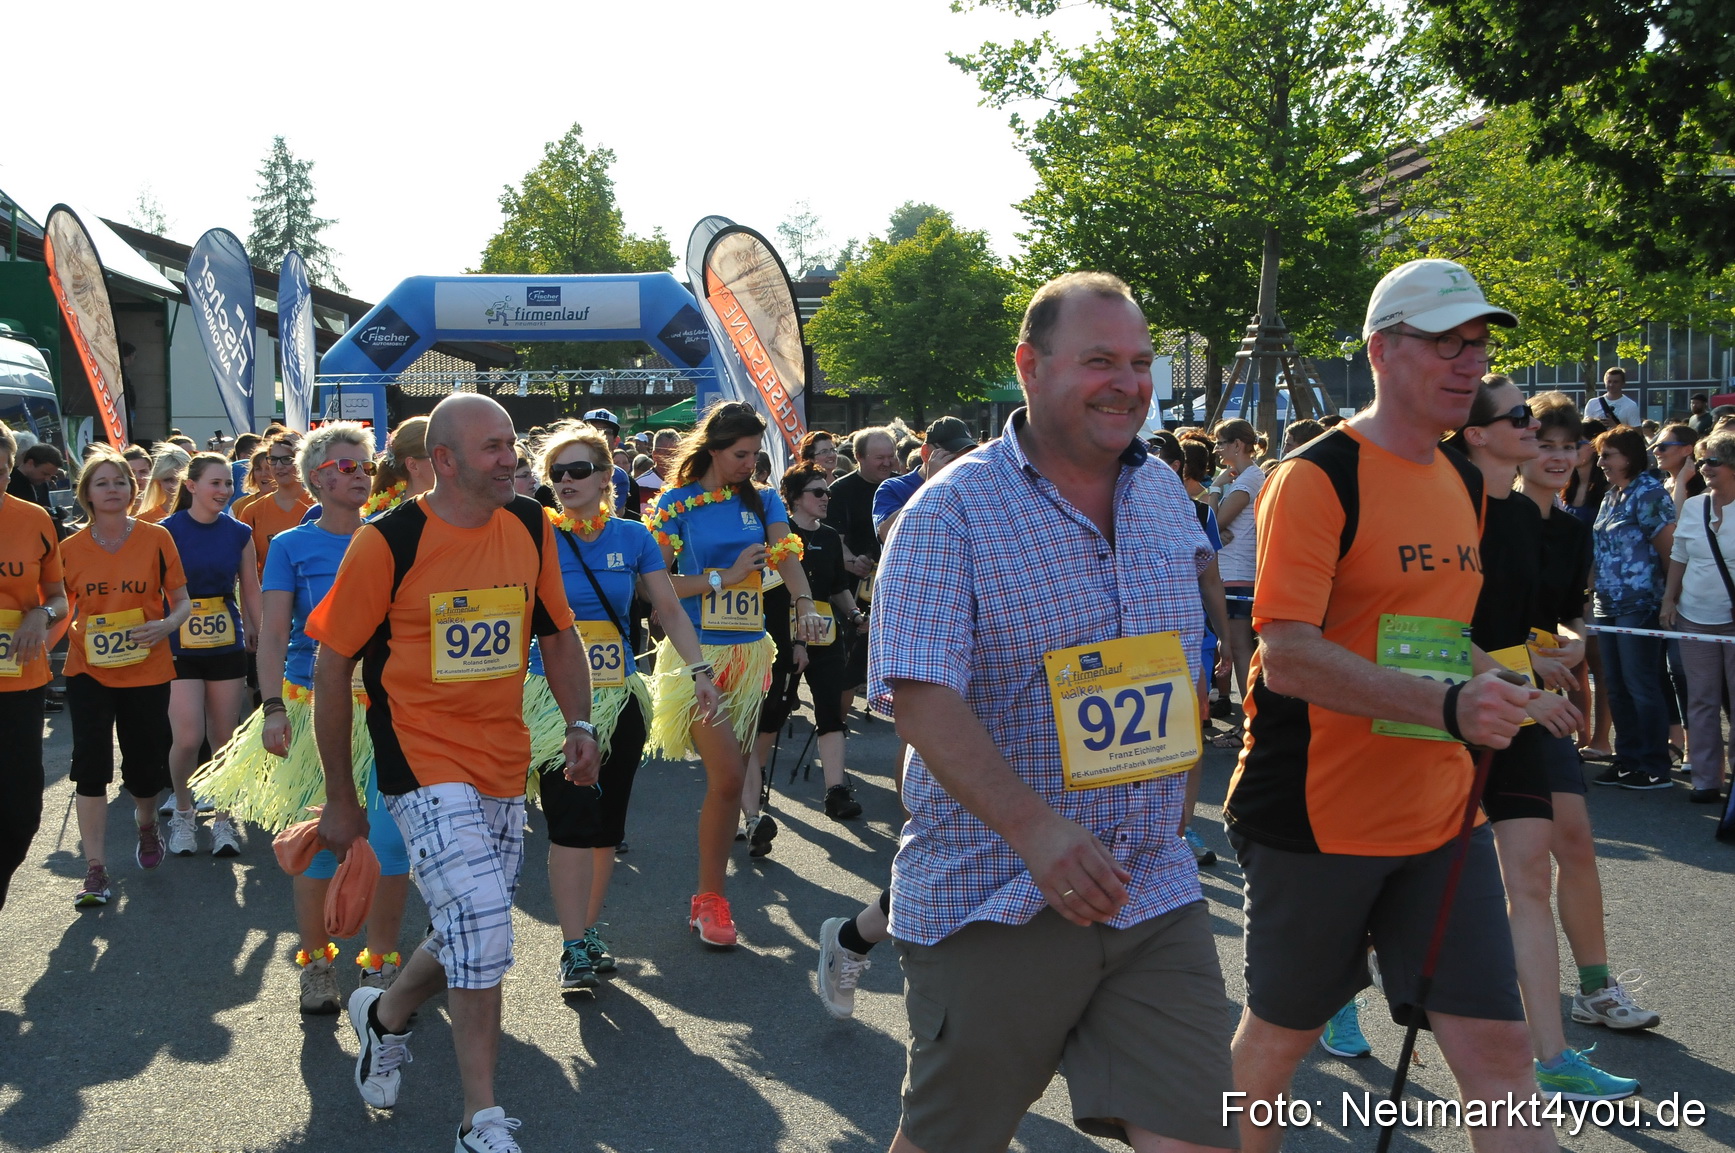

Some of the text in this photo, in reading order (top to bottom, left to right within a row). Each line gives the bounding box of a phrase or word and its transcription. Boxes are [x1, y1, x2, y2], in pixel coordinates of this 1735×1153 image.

[515, 307, 590, 320] firmenlauf
[368, 332, 410, 342] Fischer
[122, 581, 146, 593] KU
[705, 590, 759, 615] 1161
[188, 614, 227, 636] 656
[437, 617, 465, 625] walken
[93, 630, 139, 655] 925
[445, 620, 511, 659] 928
[588, 644, 621, 670] 63
[1073, 662, 1123, 681] firmenlauf
[1061, 684, 1104, 699] walken
[1077, 682, 1173, 751] 927
[1109, 743, 1166, 760] Franz Eichinger
[1072, 761, 1146, 779] PE-Kunststoff-Fabrik
[1147, 752, 1179, 765] Woffenbach
[1180, 749, 1197, 758] GmbH
